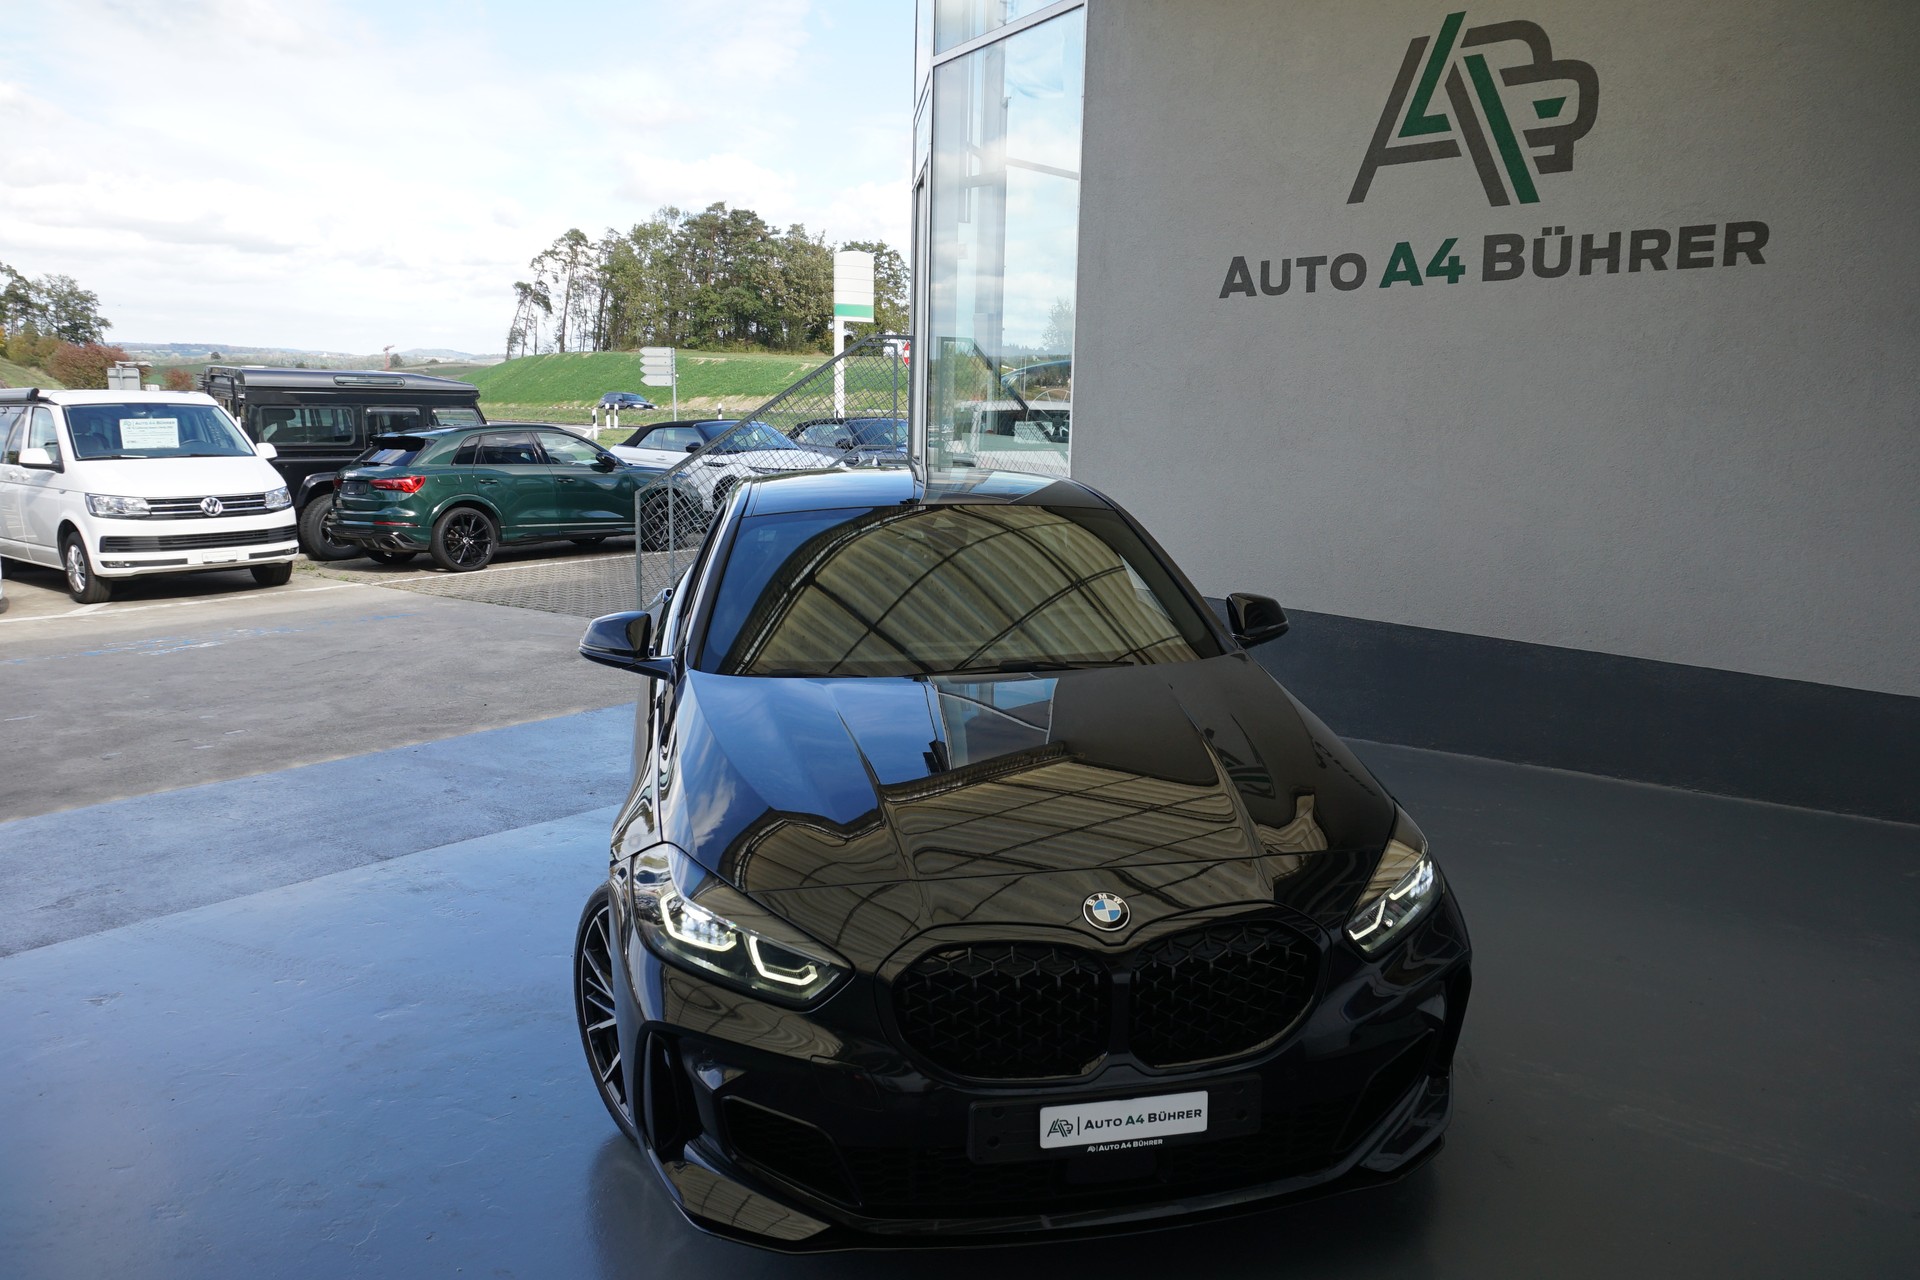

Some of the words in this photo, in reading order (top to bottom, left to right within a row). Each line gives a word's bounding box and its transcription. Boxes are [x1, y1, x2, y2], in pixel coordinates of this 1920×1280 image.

[1219, 253, 1367, 298] AUTO
[1379, 238, 1466, 288] A4
[1482, 221, 1770, 282] BÜHRER
[1087, 893, 1123, 906] BMW
[1084, 1118, 1122, 1130] AUTO
[1125, 1115, 1145, 1126] A4
[1147, 1109, 1202, 1123] BÜHRER
[1099, 1144, 1119, 1152] AUTO
[1132, 1139, 1163, 1148] BÜHRER
